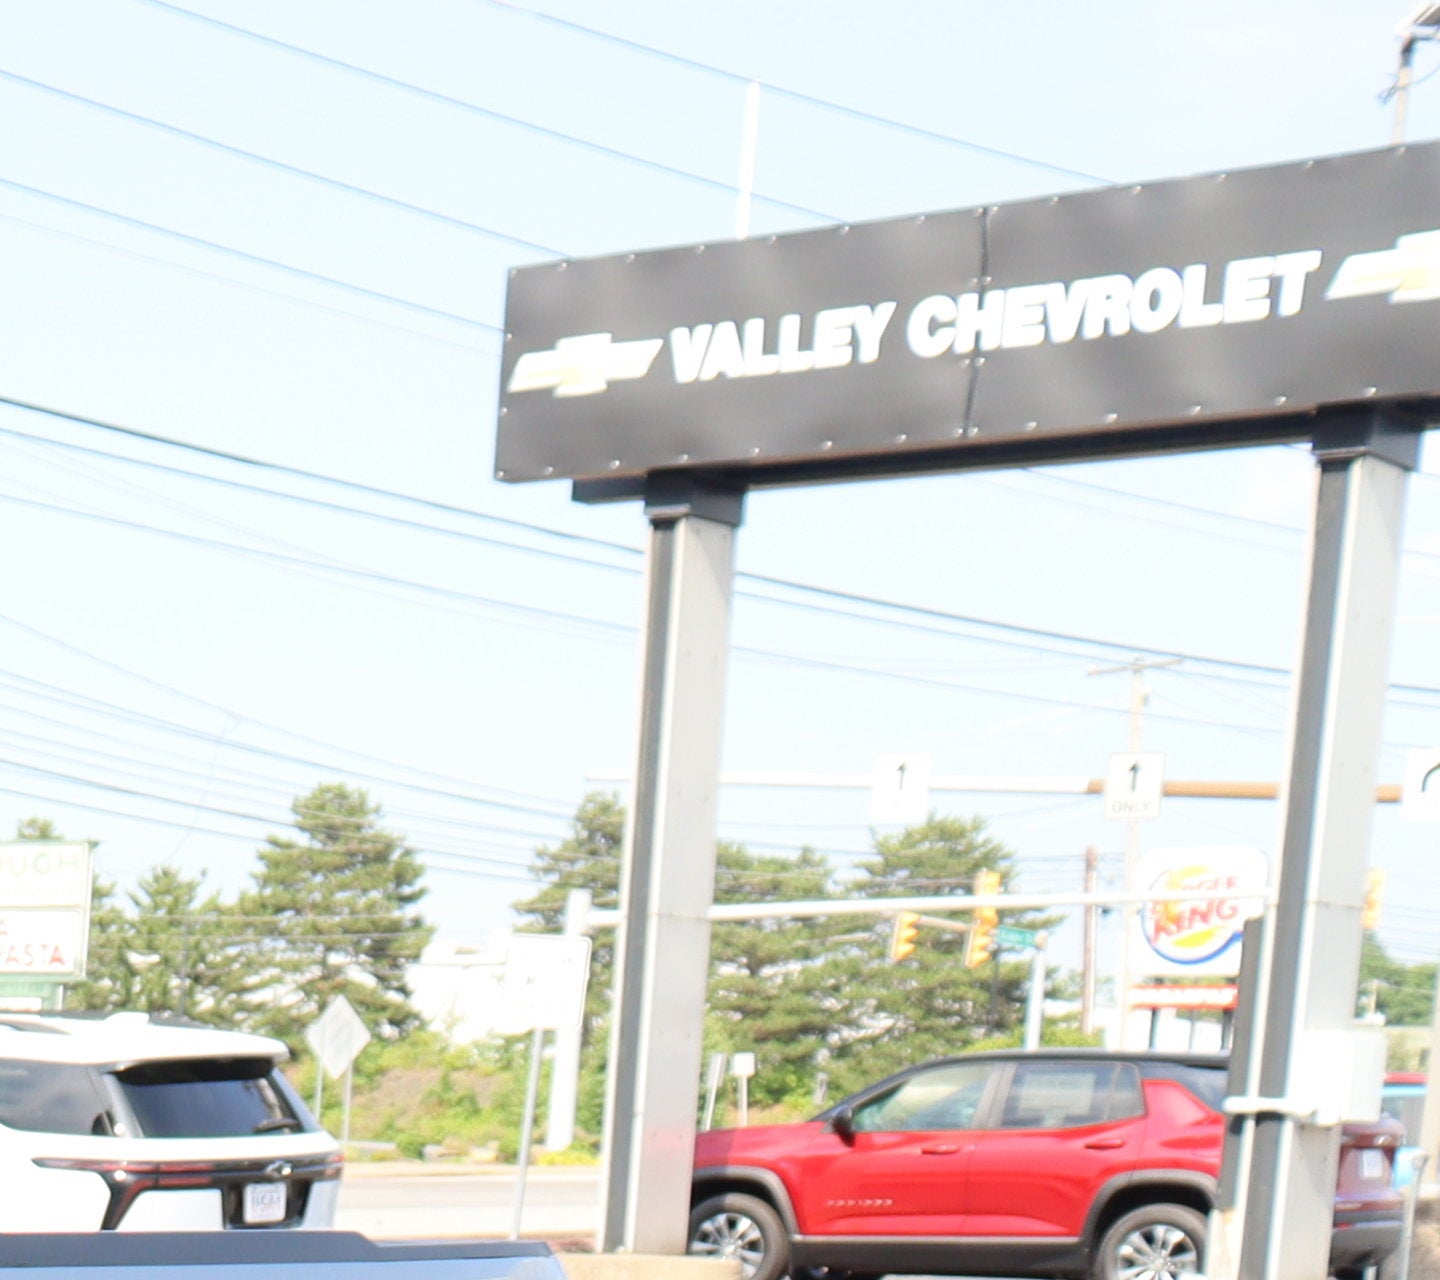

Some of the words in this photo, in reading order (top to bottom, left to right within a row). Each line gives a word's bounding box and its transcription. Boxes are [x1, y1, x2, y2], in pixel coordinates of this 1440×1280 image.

[667, 300, 898, 384] VALLEY
[906, 250, 1323, 358] CHEVROLET
[1111, 800, 1152, 814] ONLY
[1151, 898, 1240, 944] KING
